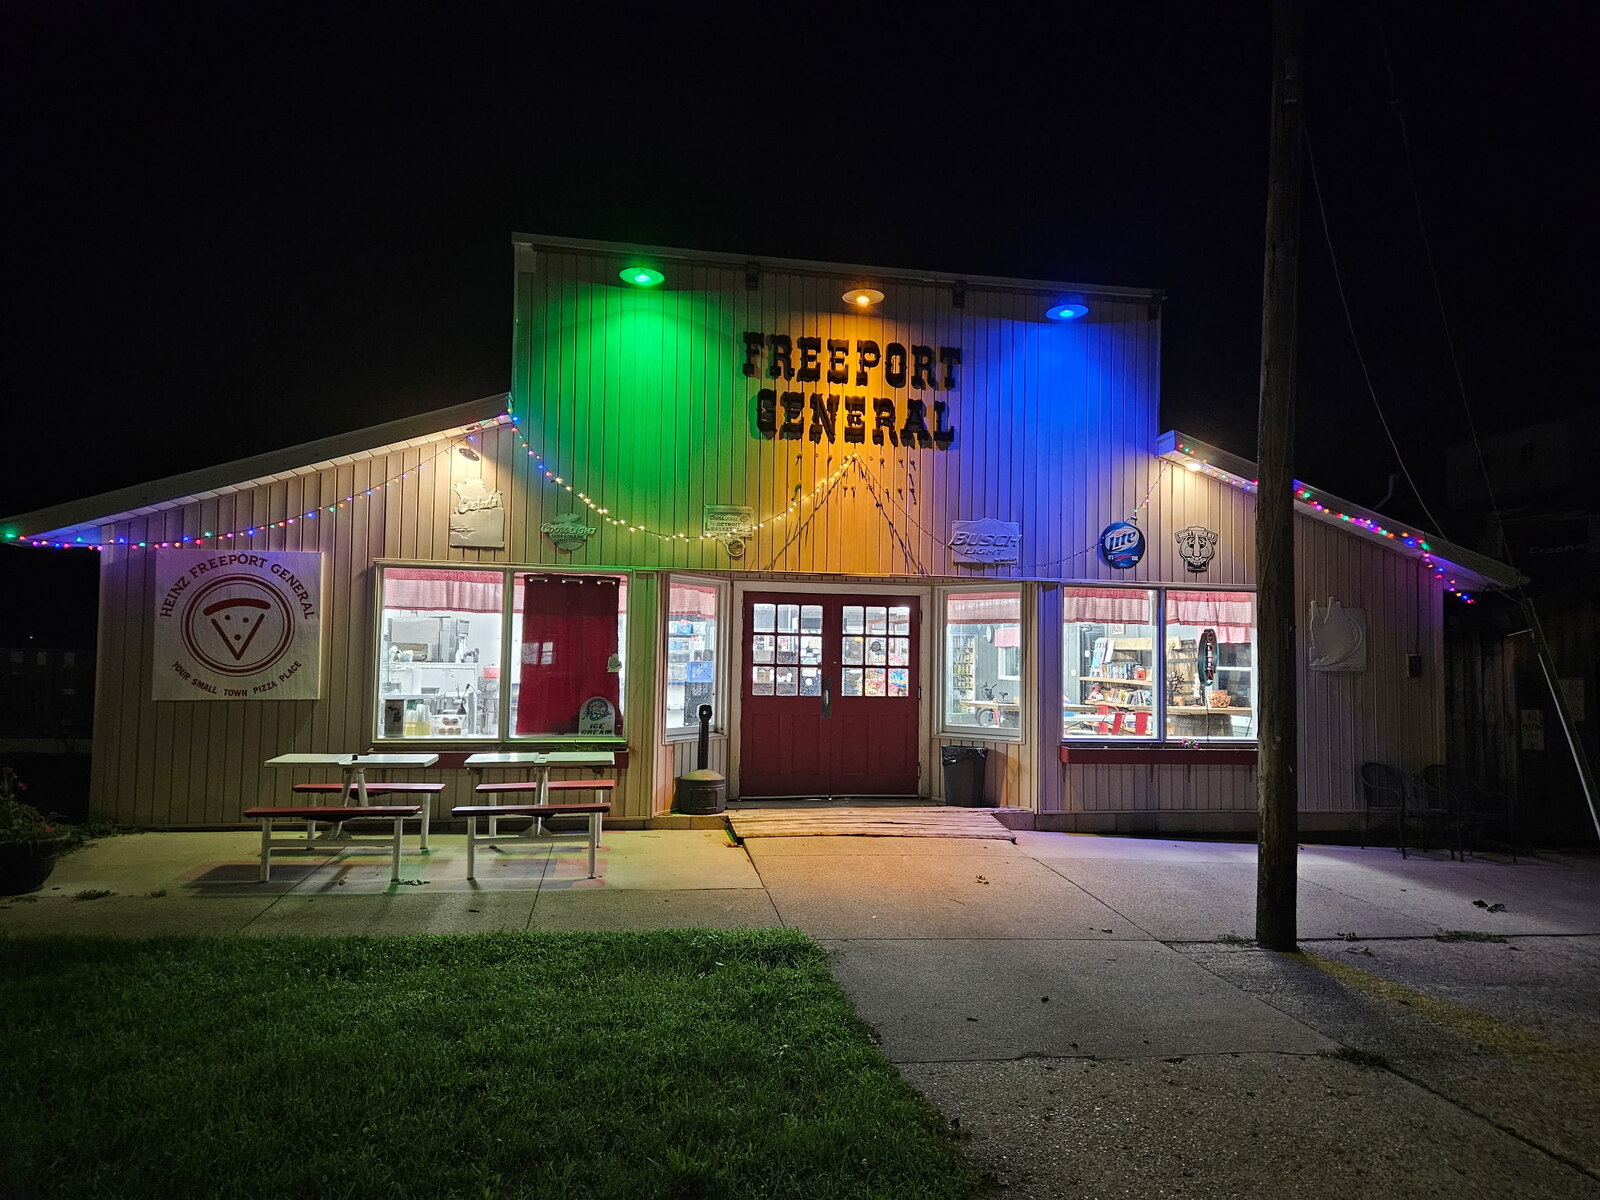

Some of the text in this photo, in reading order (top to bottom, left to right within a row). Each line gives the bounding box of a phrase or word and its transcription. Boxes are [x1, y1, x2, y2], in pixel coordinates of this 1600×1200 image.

[743, 331, 962, 390] FREEPORT
[756, 388, 955, 450] GENERAL
[570, 527, 597, 535] LIGHT
[948, 532, 1022, 547] BUSCH
[1108, 531, 1136, 552] Lite
[964, 547, 1005, 556] LIGHT
[160, 553, 315, 620] HEINZ FREEPORT GENERAL
[172, 660, 302, 697] YOUR SMALL TOWN PIZZA PLACE
